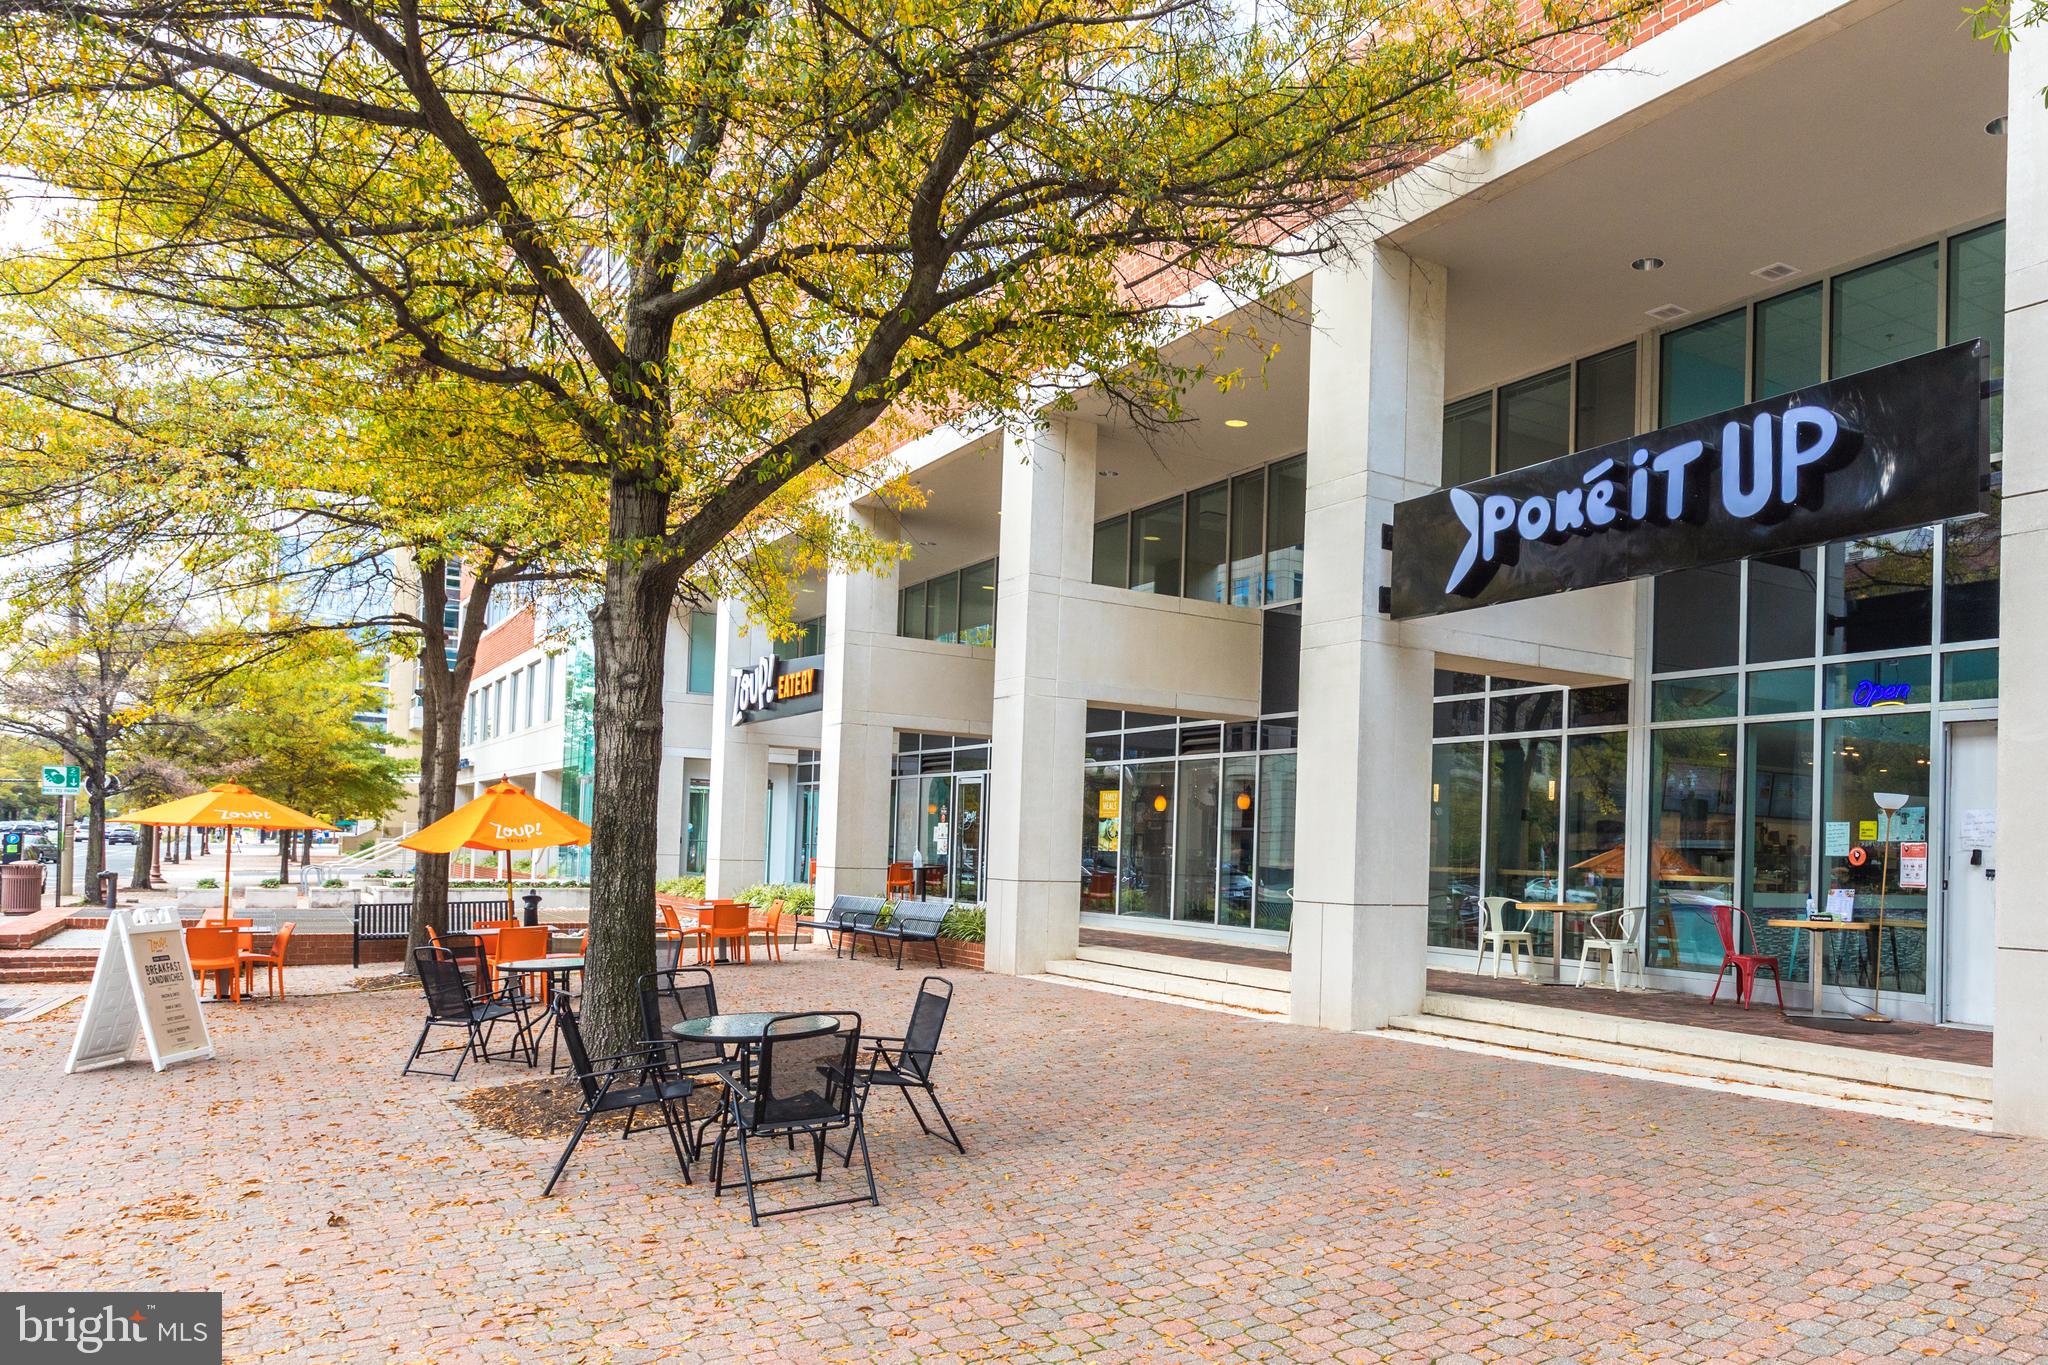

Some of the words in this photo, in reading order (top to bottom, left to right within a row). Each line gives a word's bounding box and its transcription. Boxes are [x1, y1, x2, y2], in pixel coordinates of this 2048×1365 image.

[1721, 405, 1839, 518] UP
[777, 667, 815, 700] EATERY
[1853, 680, 1912, 708] Open
[489, 822, 543, 839] Zoup!
[145, 961, 181, 976] BREAKFAST
[147, 972, 184, 986] SANDWICHES
